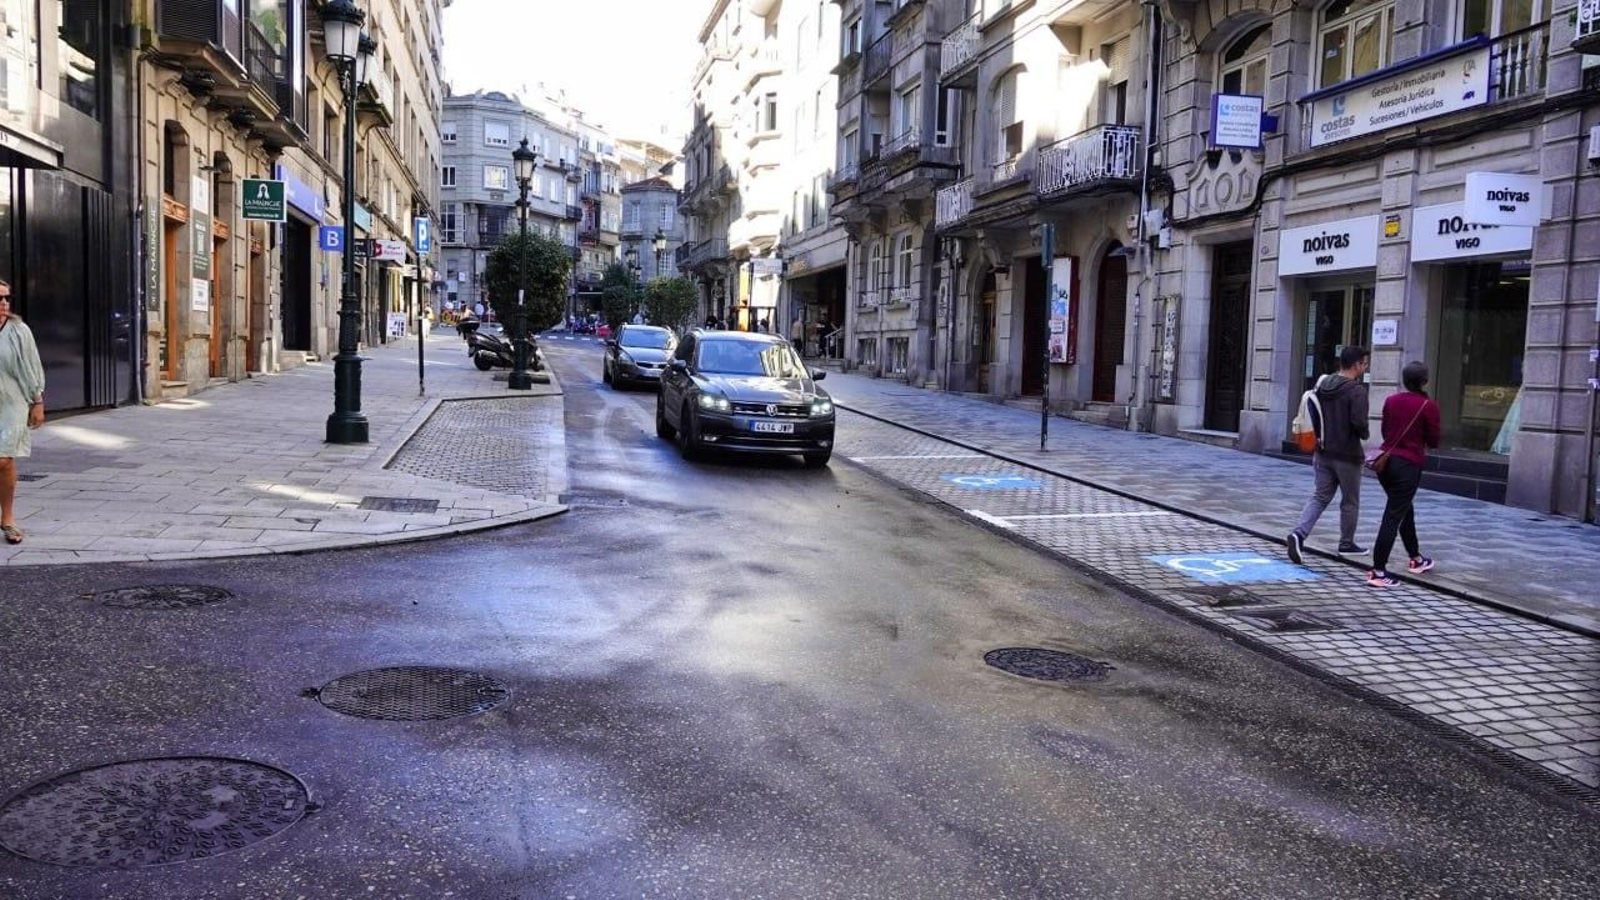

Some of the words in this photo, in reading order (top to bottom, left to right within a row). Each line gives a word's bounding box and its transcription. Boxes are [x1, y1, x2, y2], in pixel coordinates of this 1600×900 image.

[1320, 114, 1355, 133] costas
[1486, 187, 1530, 202] noivas
[1499, 204, 1516, 212] VIGO
[418, 223, 427, 249] P
[1302, 231, 1350, 253] noivas
[1455, 237, 1480, 249] VIGO
[1315, 255, 1334, 265] VIGO
